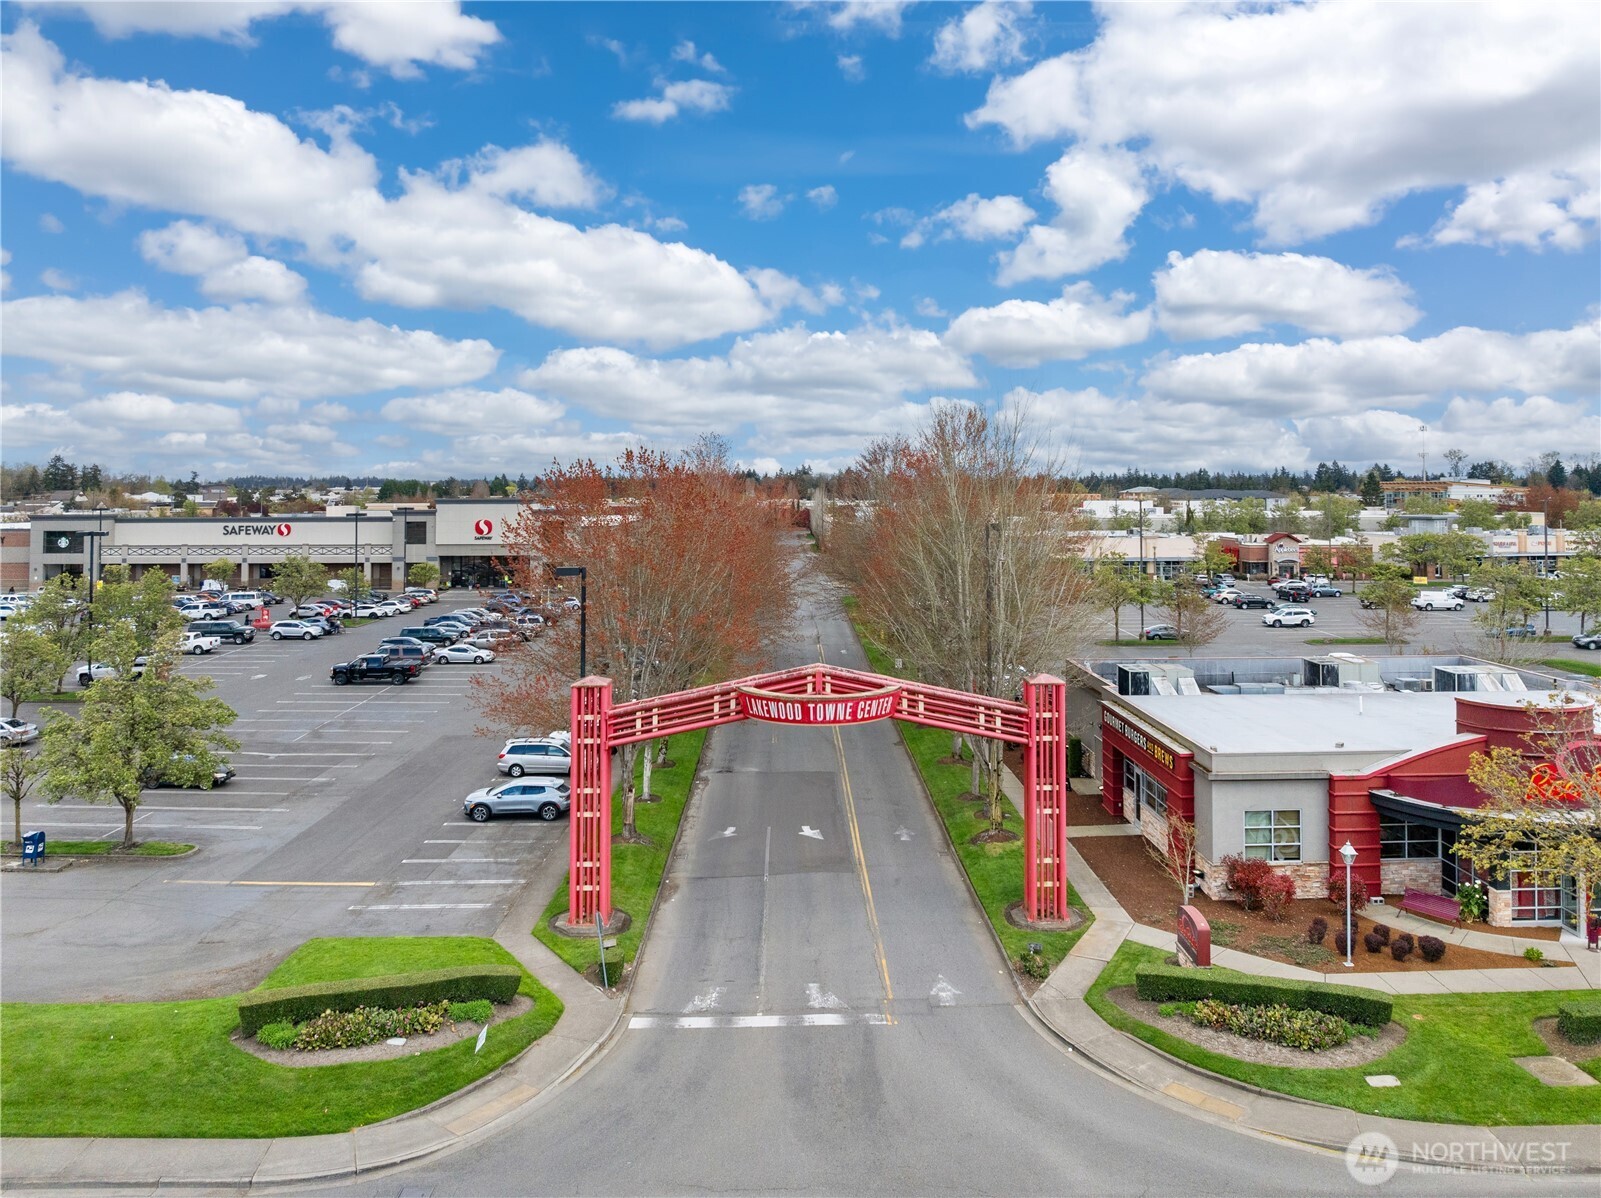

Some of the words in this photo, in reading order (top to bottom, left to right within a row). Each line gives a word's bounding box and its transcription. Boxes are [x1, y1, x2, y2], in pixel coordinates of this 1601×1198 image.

[223, 525, 276, 536] SAFEWAY
[746, 697, 802, 721] LAKEWOOD
[808, 703, 852, 722] TOWNE
[857, 696, 893, 720] CENTER
[1104, 710, 1124, 734] GOURMET
[1124, 724, 1147, 750] BURGERS
[1154, 744, 1174, 769] BREWS
